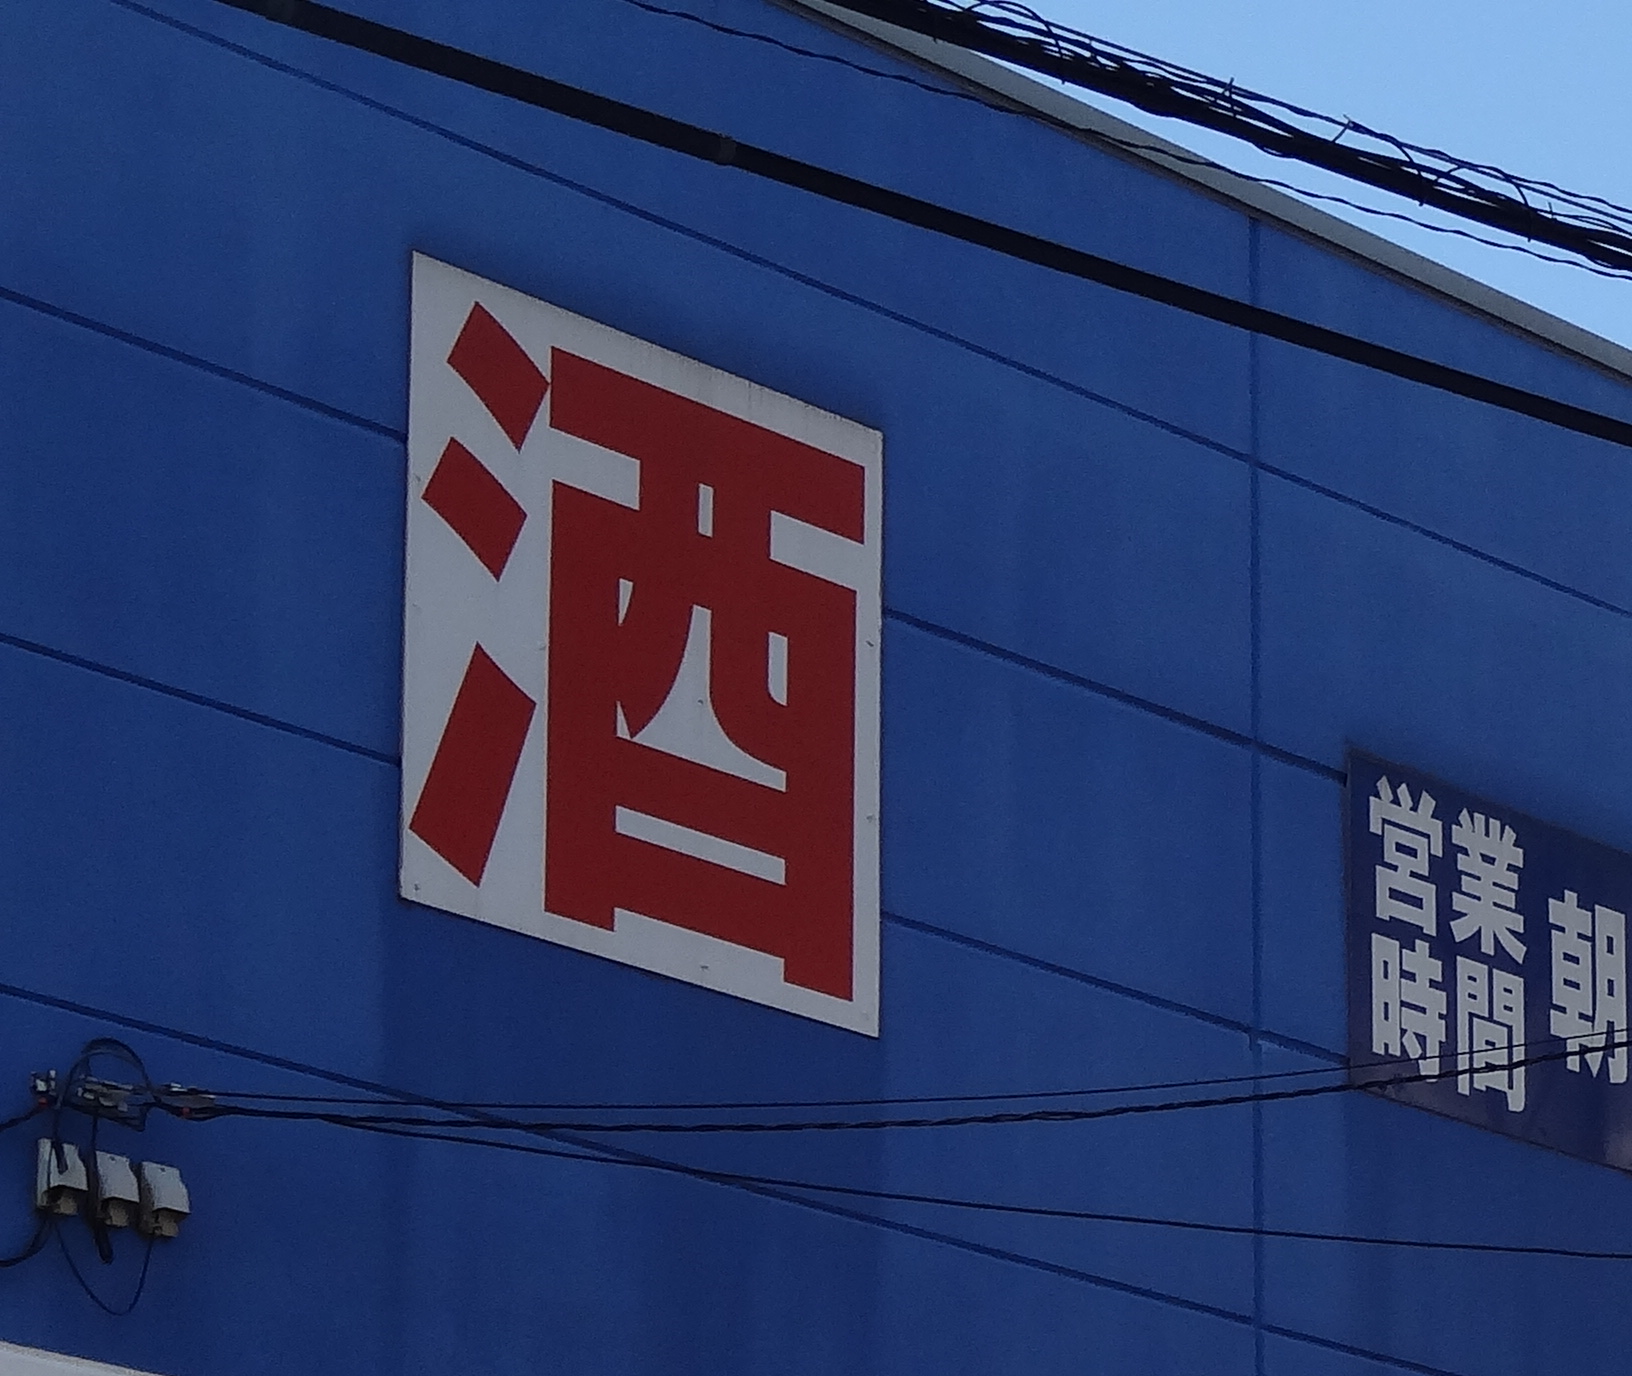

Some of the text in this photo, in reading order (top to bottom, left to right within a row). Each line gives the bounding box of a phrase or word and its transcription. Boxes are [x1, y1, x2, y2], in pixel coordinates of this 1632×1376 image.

[408, 300, 866, 1002] 酒
[1367, 776, 1527, 965] 営業
[1369, 932, 1527, 1114] 時間
[1547, 890, 1628, 1084] 朝
